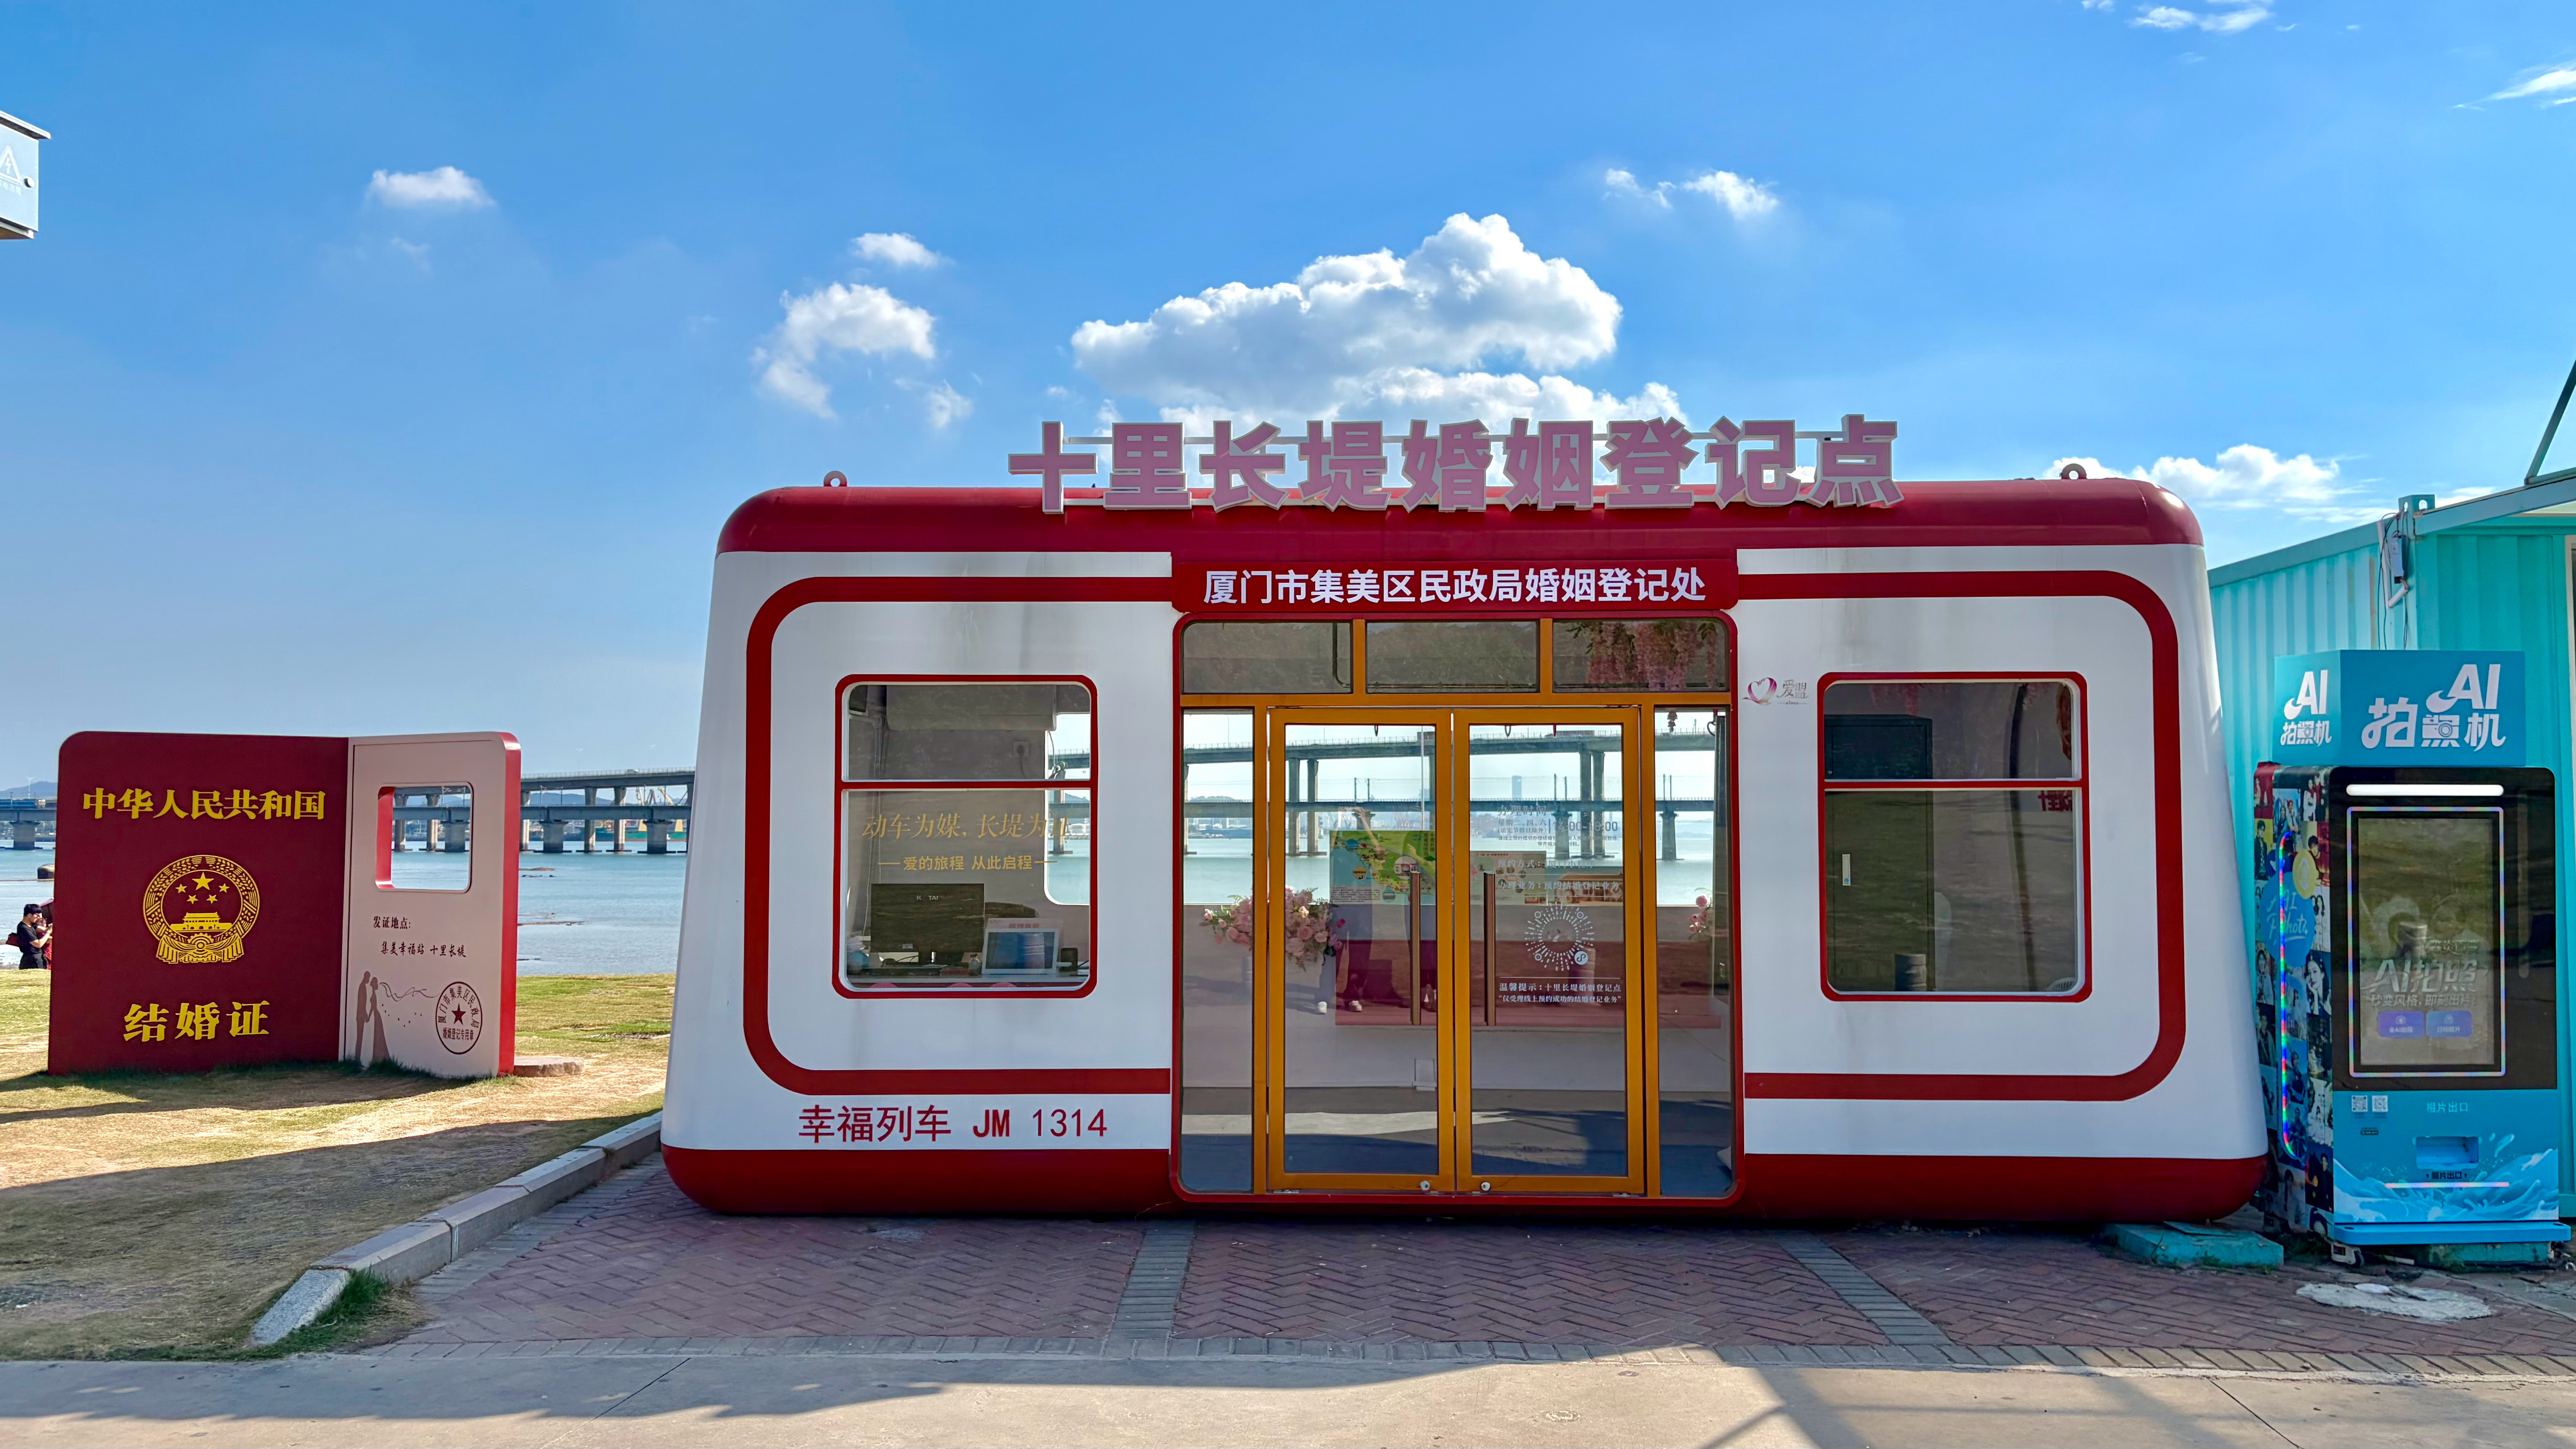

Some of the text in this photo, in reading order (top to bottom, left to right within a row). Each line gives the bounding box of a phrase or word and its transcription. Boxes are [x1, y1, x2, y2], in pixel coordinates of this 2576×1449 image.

[1007, 414, 1904, 514] 十里长堤婚姻登记点
[1204, 567, 1707, 605] 厦门市集美区民政局婚姻登记处
[1777, 679, 1809, 699] 爱盟
[2284, 669, 2329, 720] AI
[2425, 663, 2501, 713] AI
[2280, 720, 2332, 747] 拍照机
[2361, 697, 2506, 752] 拍照机
[83, 787, 325, 820] 中华人民共和国
[903, 855, 1032, 871] 爱的旅程 从此启程
[381, 941, 467, 957] 集美幸福站 十里长堤
[123, 999, 270, 1043] 结婚证
[799, 1104, 1107, 1143] 幸福列车 JM 1314
